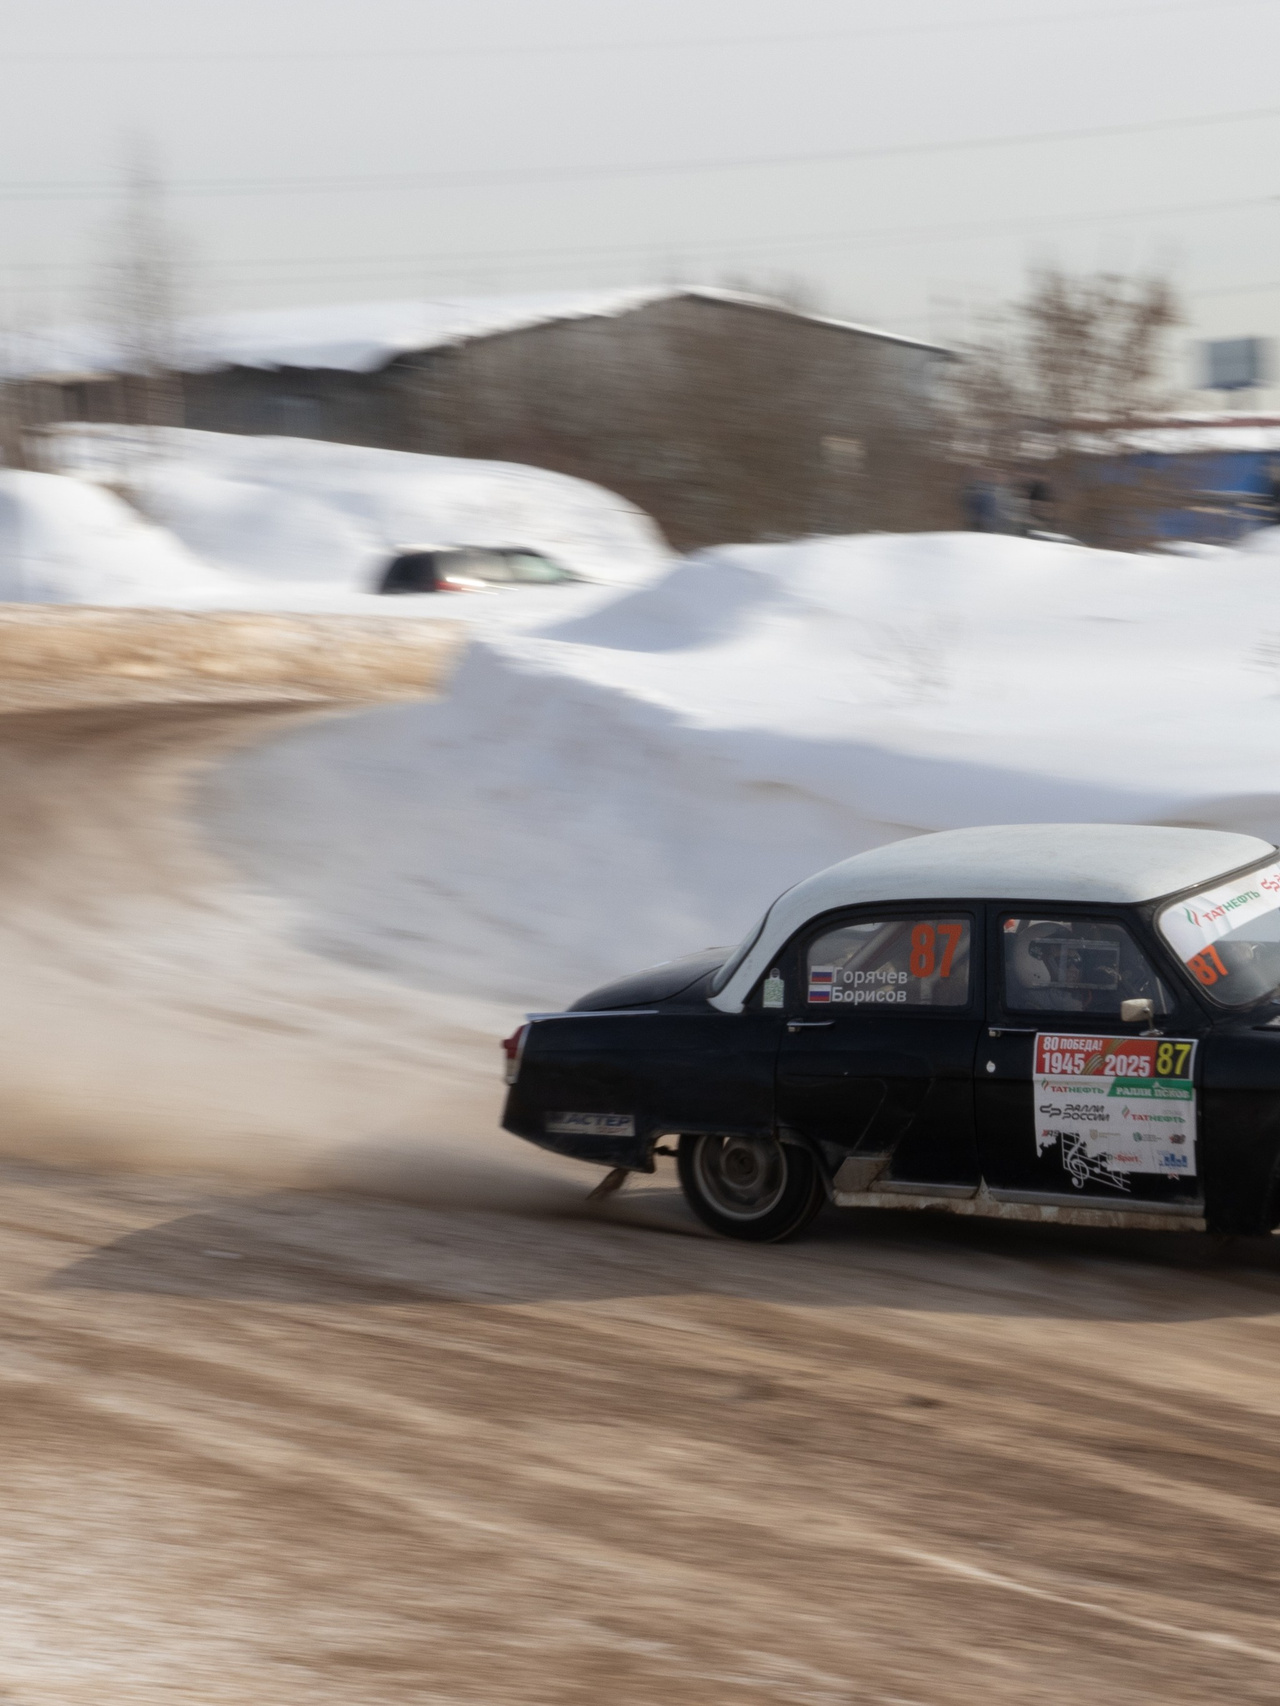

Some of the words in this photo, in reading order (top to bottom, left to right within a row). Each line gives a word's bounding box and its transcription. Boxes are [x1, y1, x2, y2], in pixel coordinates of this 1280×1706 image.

[1202, 890, 1261, 922] ТАТНЕФТЬ
[909, 923, 963, 978] 87
[1186, 944, 1229, 986] 87
[833, 967, 908, 987] Горячев
[832, 987, 907, 1005] Борисов
[1043, 1036, 1058, 1050] 80
[1060, 1040, 1103, 1052] ПОБЕДА!
[1042, 1053, 1086, 1074] 1945
[1104, 1054, 1151, 1077] 2025
[1156, 1043, 1192, 1075] 87
[1051, 1085, 1105, 1094] ТАТНЕФТЬ
[1062, 1112, 1110, 1122] РОССИИ
[1064, 1104, 1105, 1113] РАЛЛИ
[1131, 1114, 1186, 1124] ТАТНЕФТЬ
